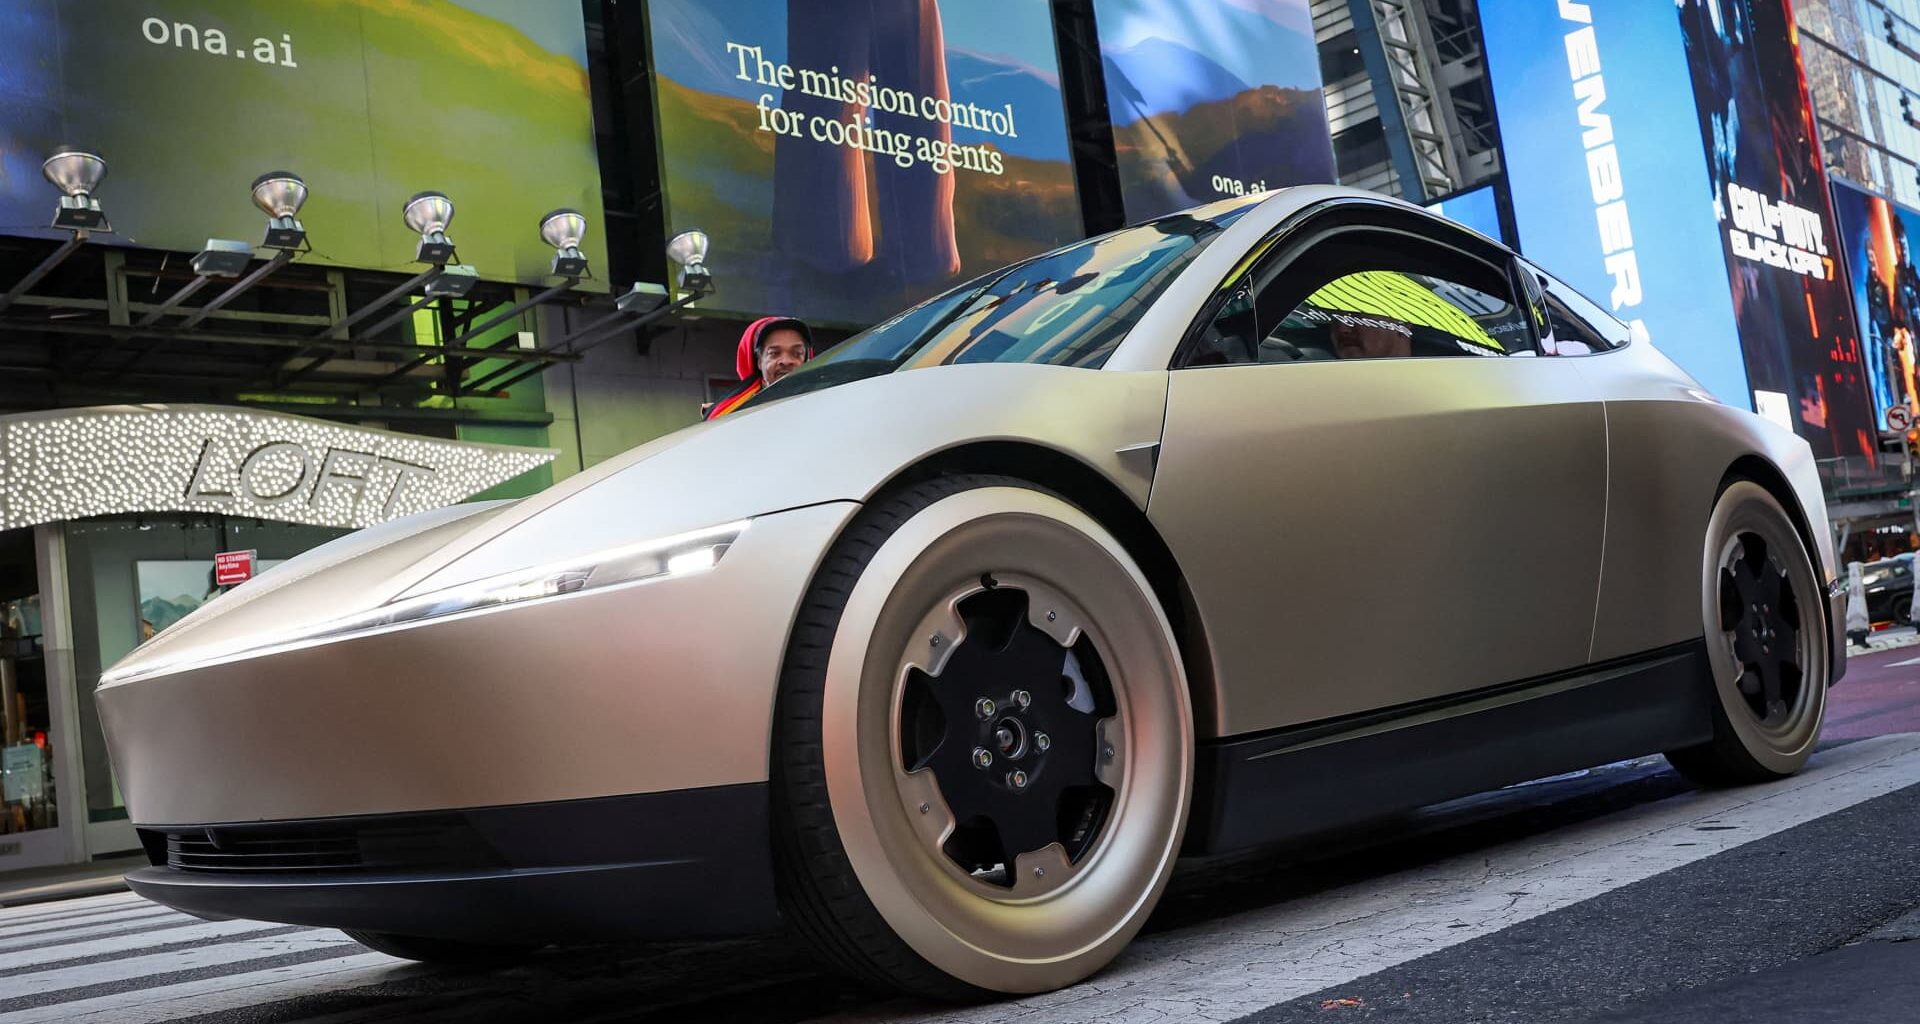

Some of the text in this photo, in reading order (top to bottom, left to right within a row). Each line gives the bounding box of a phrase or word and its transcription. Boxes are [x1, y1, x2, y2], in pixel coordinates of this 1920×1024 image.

[142, 17, 297, 68] ona.ai
[727, 42, 1018, 138] The mission control
[757, 93, 1004, 175] for coding agents
[1728, 182, 1778, 241] CALL
[1729, 228, 1834, 282] BLACK OPS 7
[183, 438, 437, 520] LOFT
